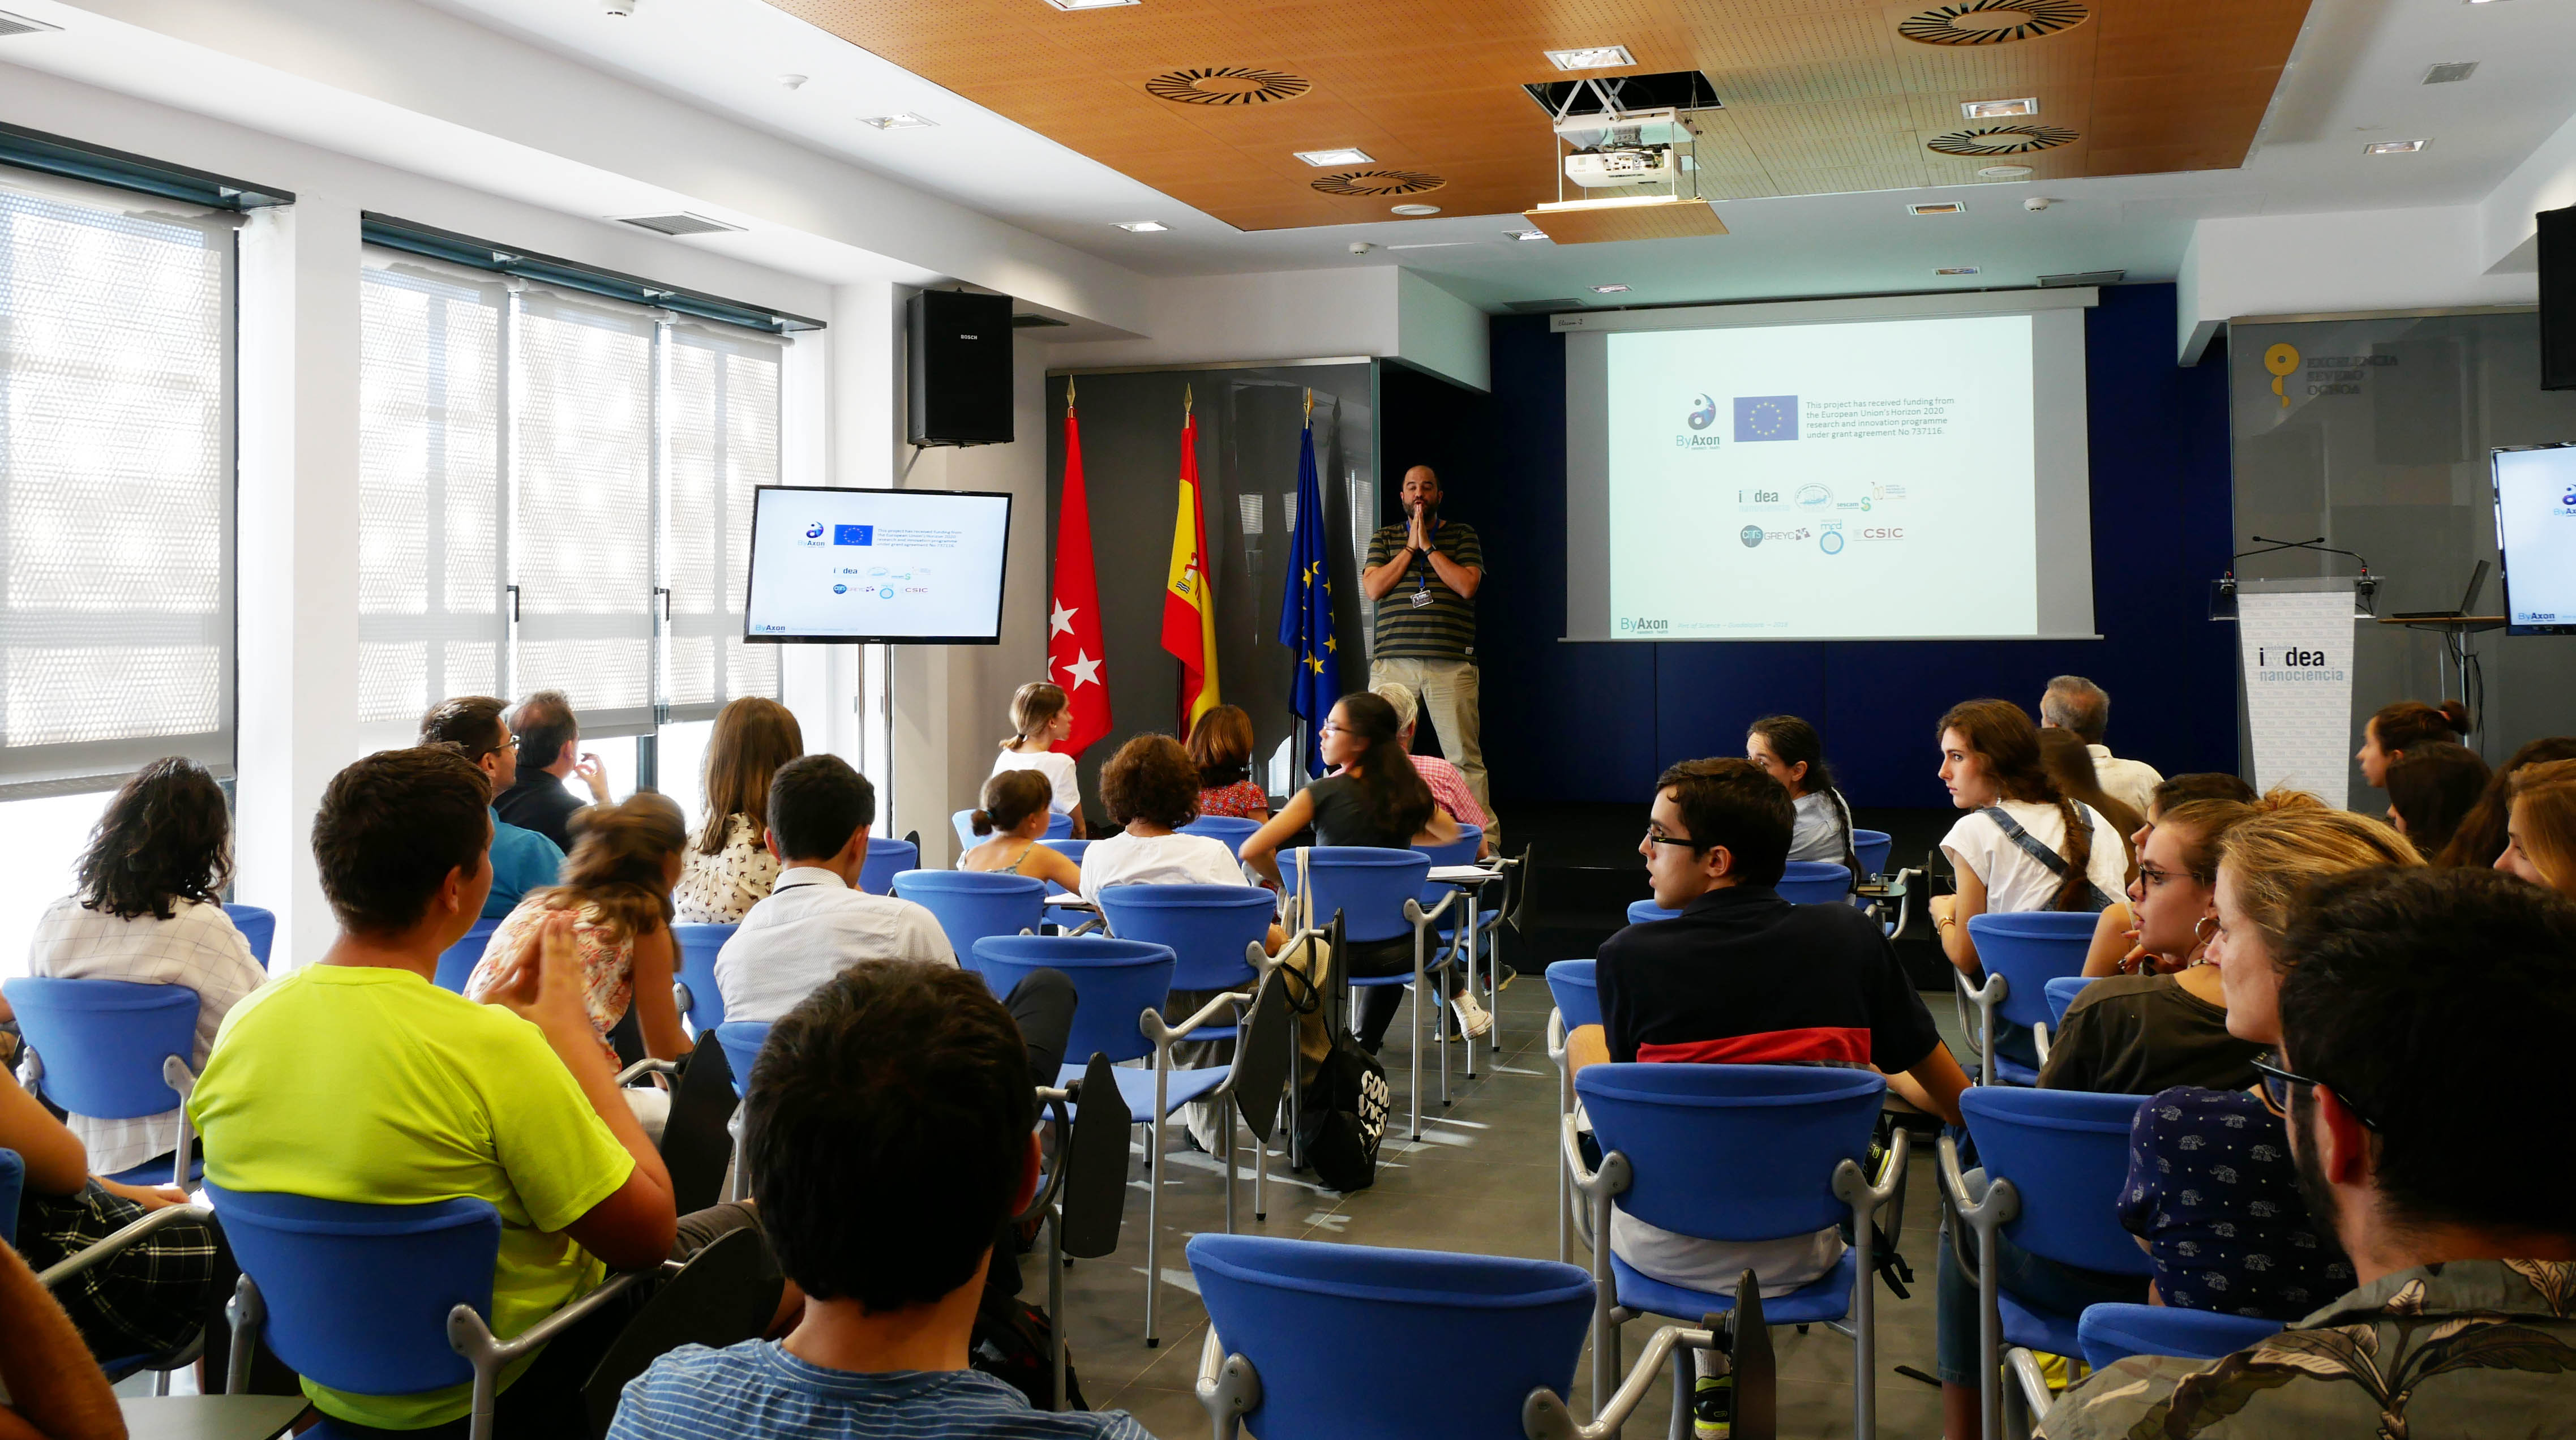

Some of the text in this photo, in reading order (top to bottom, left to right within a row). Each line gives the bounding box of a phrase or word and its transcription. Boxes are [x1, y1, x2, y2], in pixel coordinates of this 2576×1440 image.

[2306, 355, 2398, 368] EXCELENCIA
[2307, 370, 2364, 382] SEVERO
[2308, 384, 2360, 395] OCHOA
[1824, 401, 1853, 410] project
[1903, 398, 1934, 406] funding
[1821, 410, 1858, 419] European
[1806, 420, 1840, 428] research
[1902, 417, 1947, 427] programme
[1831, 430, 1853, 439] grant
[1853, 429, 1896, 439] agreement
[1676, 435, 1720, 448] ByAxon
[1764, 531, 1794, 541] GREYC
[1863, 528, 1904, 539] CSIC
[2518, 612, 2554, 621] ByAxon
[1621, 618, 1668, 632] ByAxon
[2260, 667, 2343, 681] nanociencia
